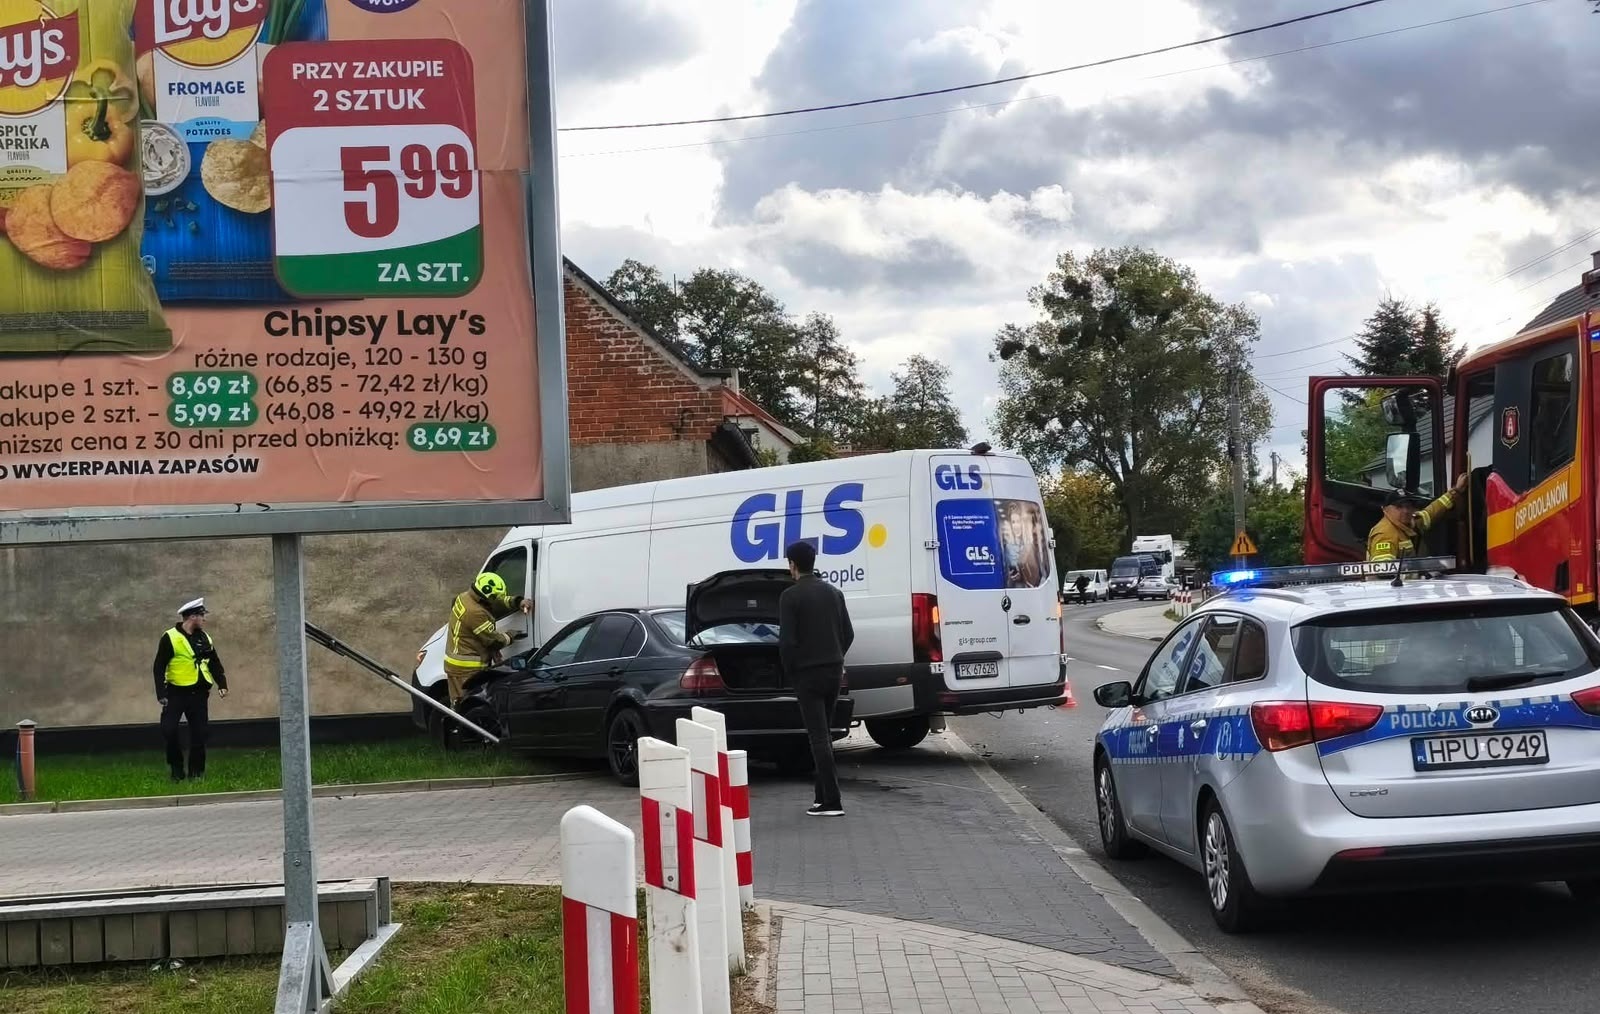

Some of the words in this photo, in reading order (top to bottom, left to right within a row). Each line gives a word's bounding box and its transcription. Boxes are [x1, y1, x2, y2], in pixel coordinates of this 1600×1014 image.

[292, 62, 347, 79] PRZY
[353, 61, 443, 78] ZAKUPIE
[168, 81, 245, 95] FROMAGE
[195, 96, 220, 107] FLAVOUR
[313, 90, 329, 111] 2
[336, 89, 425, 111] SZTUK
[0, 124, 38, 137] SPICY
[186, 128, 231, 136] POTATOES
[8, 151, 30, 160] FLAVOUR
[378, 263, 411, 282] ZA
[417, 263, 469, 282] SZT.
[264, 308, 388, 345] Chipsy
[397, 310, 486, 344] Lay’s
[195, 348, 258, 367] różne
[266, 348, 356, 370] rodzaje,
[364, 348, 402, 366] 120
[428, 347, 465, 365] 130
[473, 351, 487, 370] g
[84, 378, 93, 396] 1
[102, 379, 140, 396] szt.
[172, 376, 221, 399] 8,69
[228, 375, 250, 395] zł
[265, 375, 332, 397] (66,85
[357, 374, 415, 395] 72,42
[423, 374, 488, 396] zł/kg)
[83, 405, 96, 423] 2
[103, 406, 140, 423] szt.
[174, 403, 222, 426] 5,99
[228, 402, 250, 421] zł
[265, 402, 334, 424] (46,08
[359, 401, 416, 422] 49,92
[423, 401, 489, 424] zł/kg)
[71, 435, 127, 451] cena
[135, 435, 146, 450] z
[154, 432, 181, 450] 30
[188, 430, 223, 449] dni
[233, 429, 297, 453] przed
[305, 427, 399, 450] obniżką:
[413, 427, 462, 450] 8,69
[468, 426, 490, 446] zł
[158, 454, 259, 475] ZAPASÓW
[1515, 507, 1527, 530] OSP
[1528, 481, 1568, 520] ODOLANÓW
[1343, 563, 1398, 575] POLICJA
[961, 664, 972, 676] PK
[1391, 712, 1458, 729] POLICJA
[1470, 710, 1492, 720] KIA
[1428, 738, 1479, 763] HPU
[1487, 734, 1541, 759] C949
